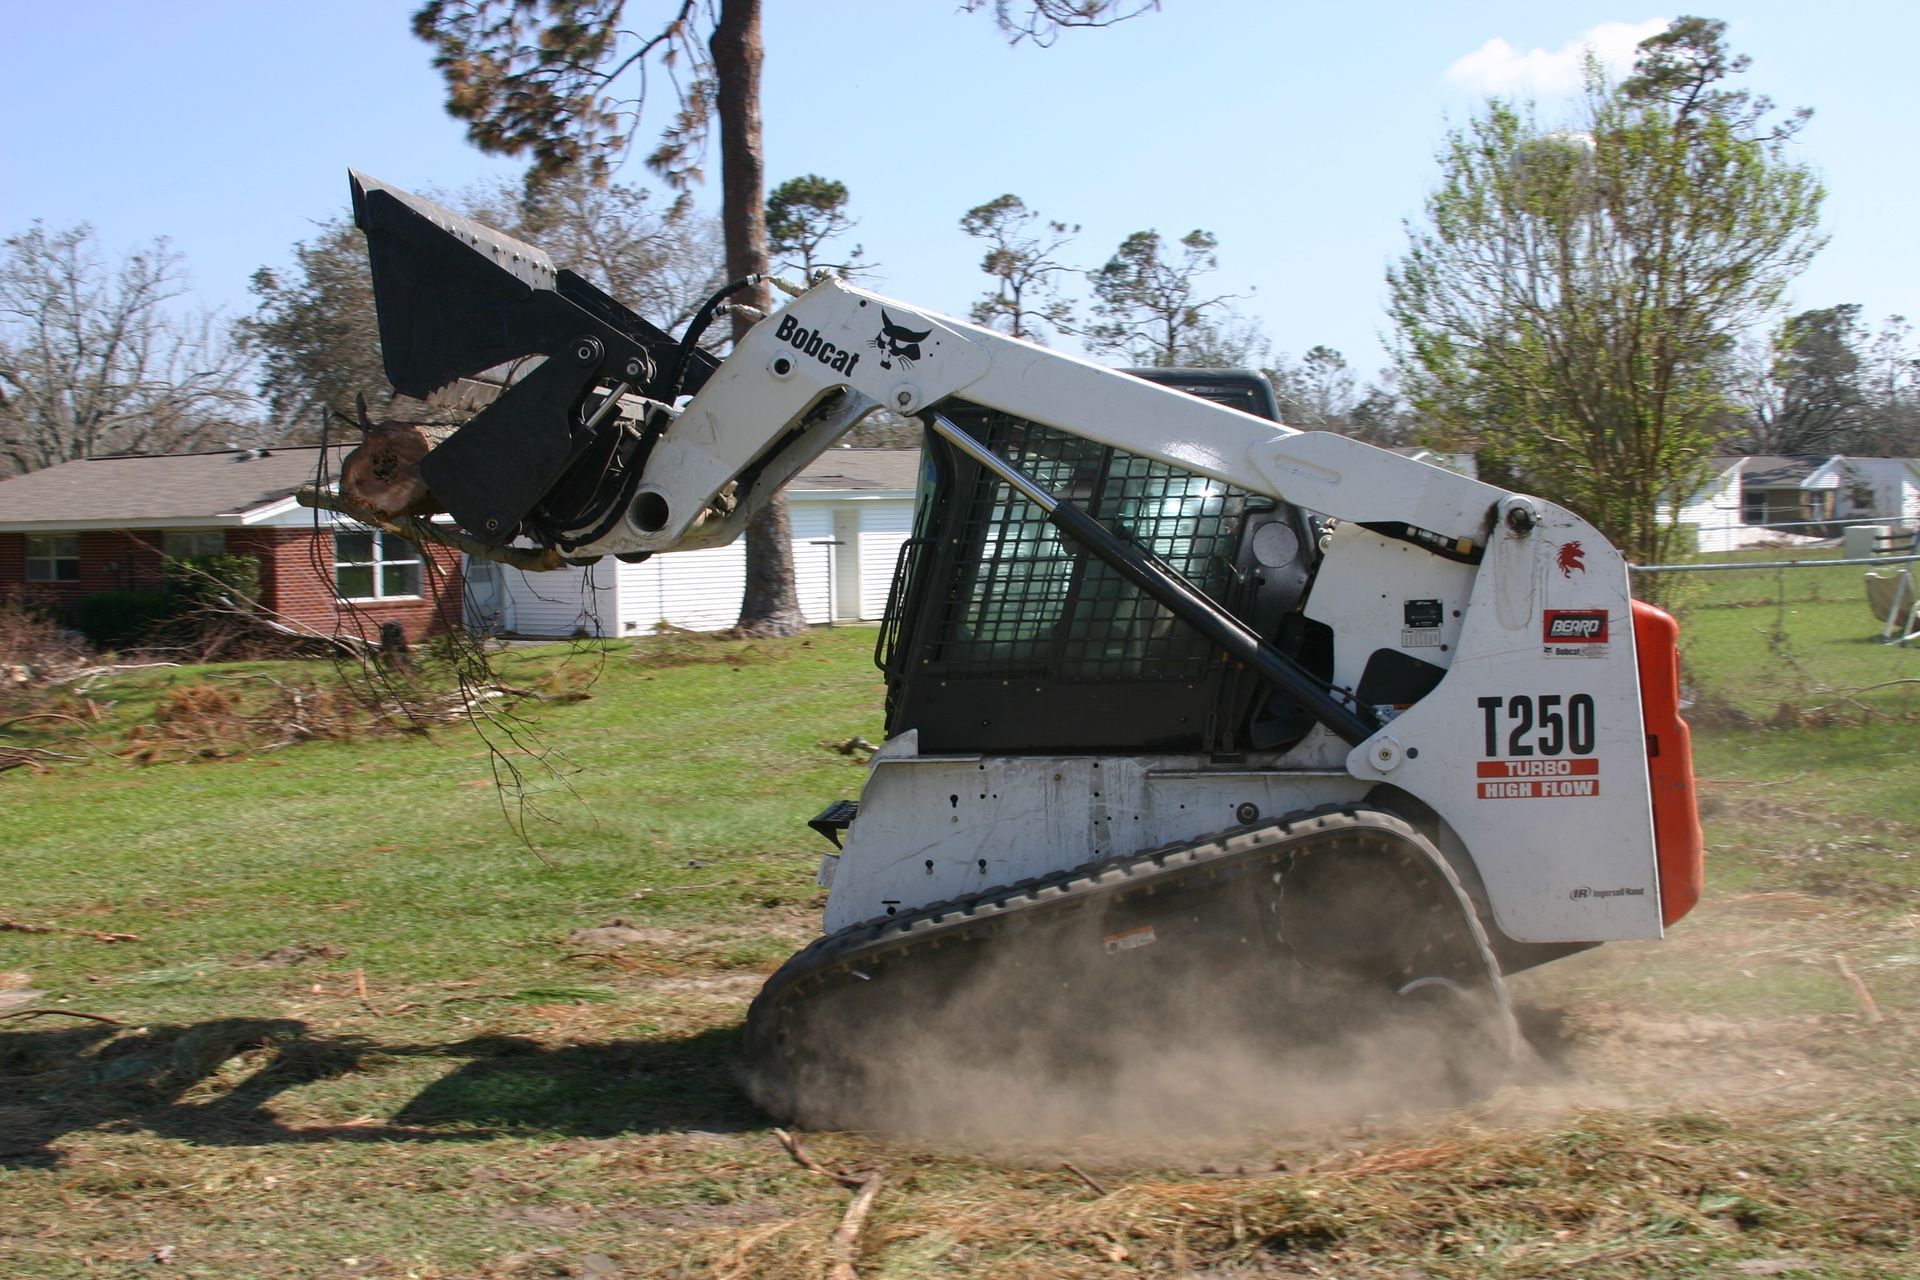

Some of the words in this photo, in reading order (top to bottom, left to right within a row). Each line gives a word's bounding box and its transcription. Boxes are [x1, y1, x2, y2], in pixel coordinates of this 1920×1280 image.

[775, 314, 860, 377] Bobcat
[1551, 619, 1599, 638] BEARD
[1478, 693, 1595, 757] T250
[1505, 760, 1571, 777] TURBO
[1485, 783, 1532, 798] HIGH
[1541, 781, 1593, 797] FLOW
